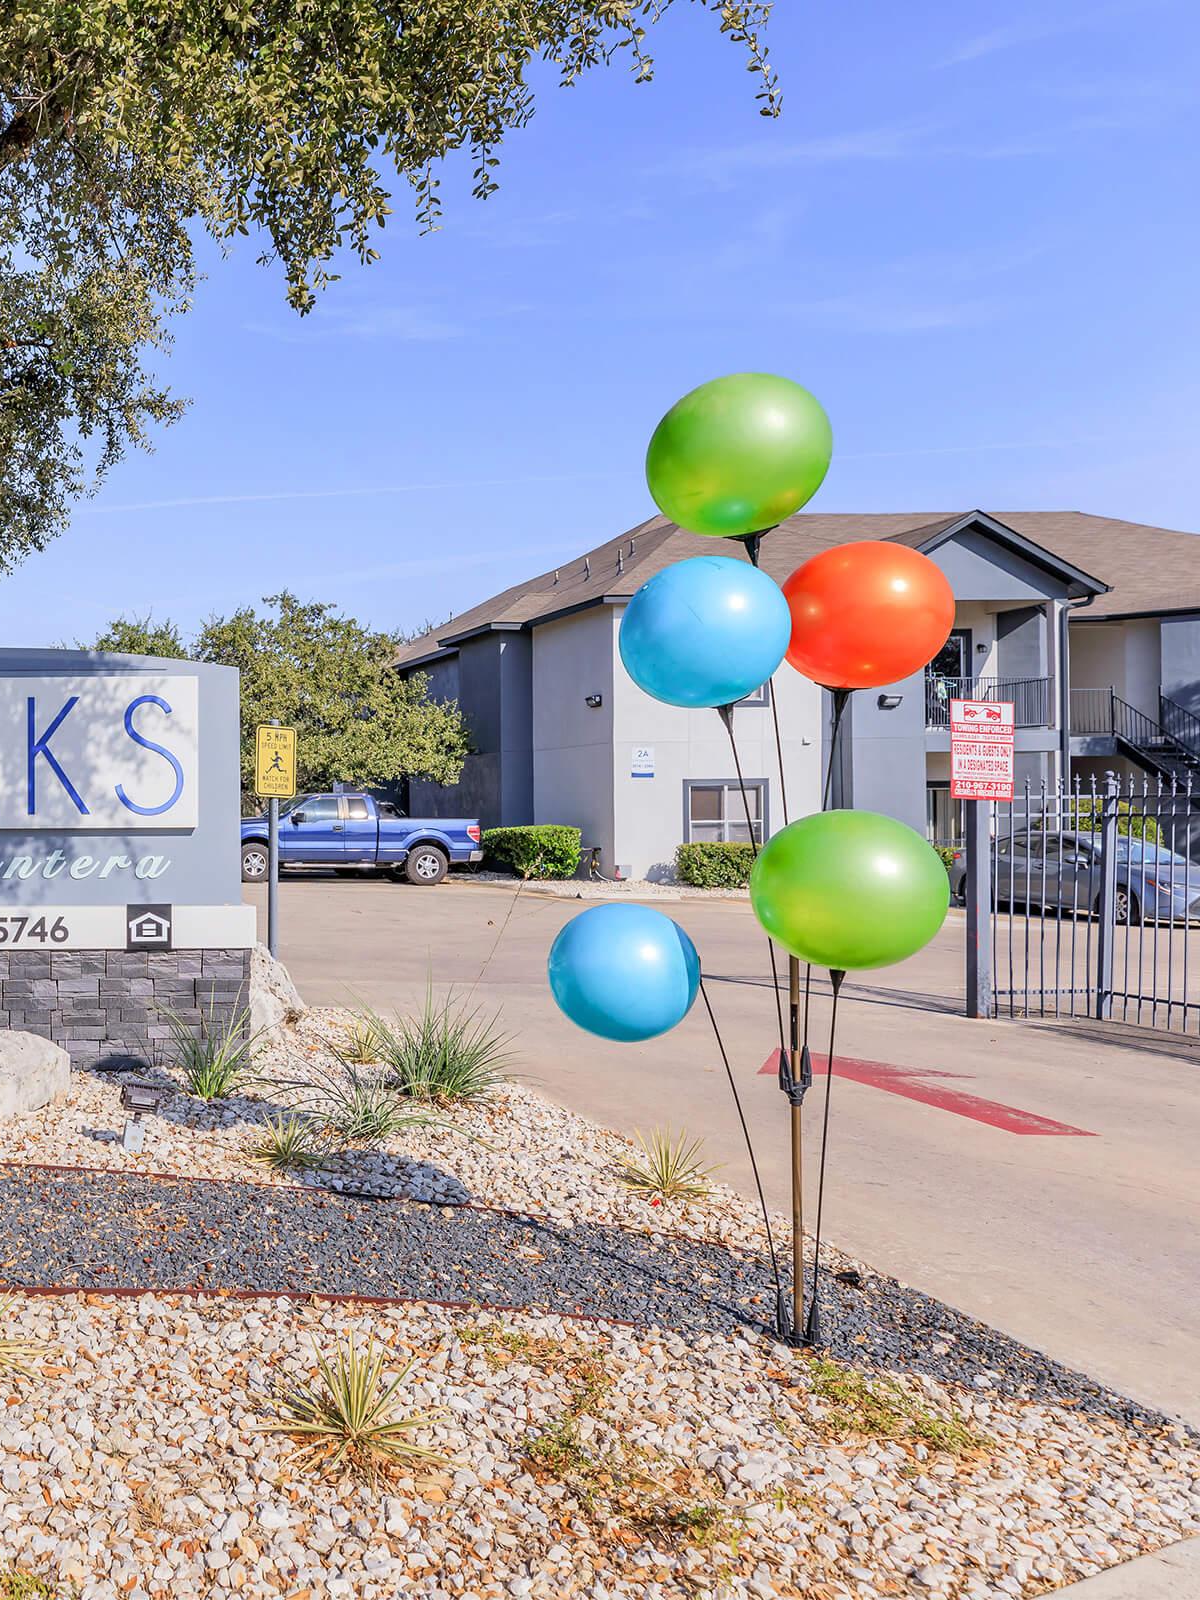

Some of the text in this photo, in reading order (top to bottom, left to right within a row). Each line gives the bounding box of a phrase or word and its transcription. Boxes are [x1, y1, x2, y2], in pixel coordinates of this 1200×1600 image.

[954, 724, 1012, 734] TOWING ENFORCED
[266, 732, 288, 742] 5 MPH
[278, 742, 292, 750] LIMIT
[954, 743, 977, 755] RESIDENTS
[982, 745, 999, 756] GUESTS
[1000, 745, 1012, 757] ONLY
[637, 750, 649, 758] 2A
[967, 759, 994, 771] DESIGNATED
[994, 760, 1008, 772] SPACE
[263, 782, 288, 790] CHILDREN
